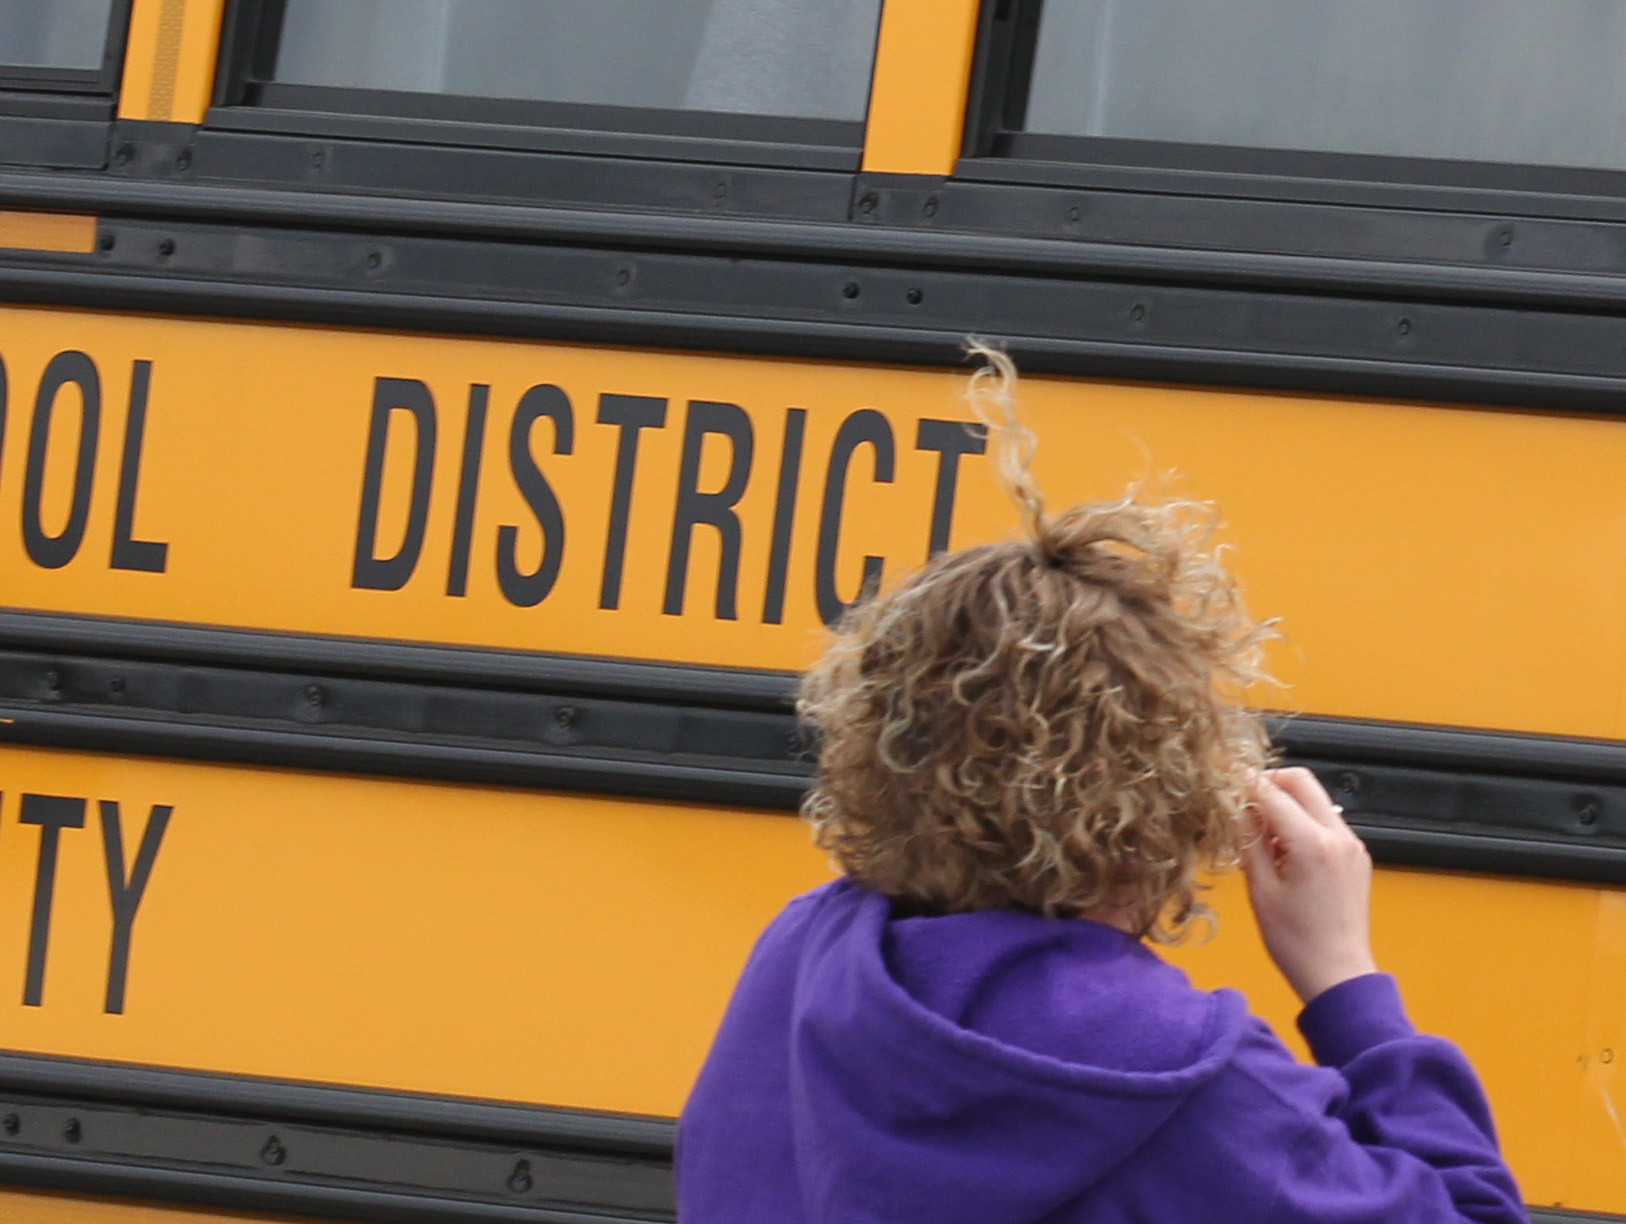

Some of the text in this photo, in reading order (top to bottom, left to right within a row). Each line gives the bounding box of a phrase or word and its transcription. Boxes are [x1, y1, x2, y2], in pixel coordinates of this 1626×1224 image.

[0, 349, 988, 634] OL DISTRICT
[0, 791, 174, 1016] TY
